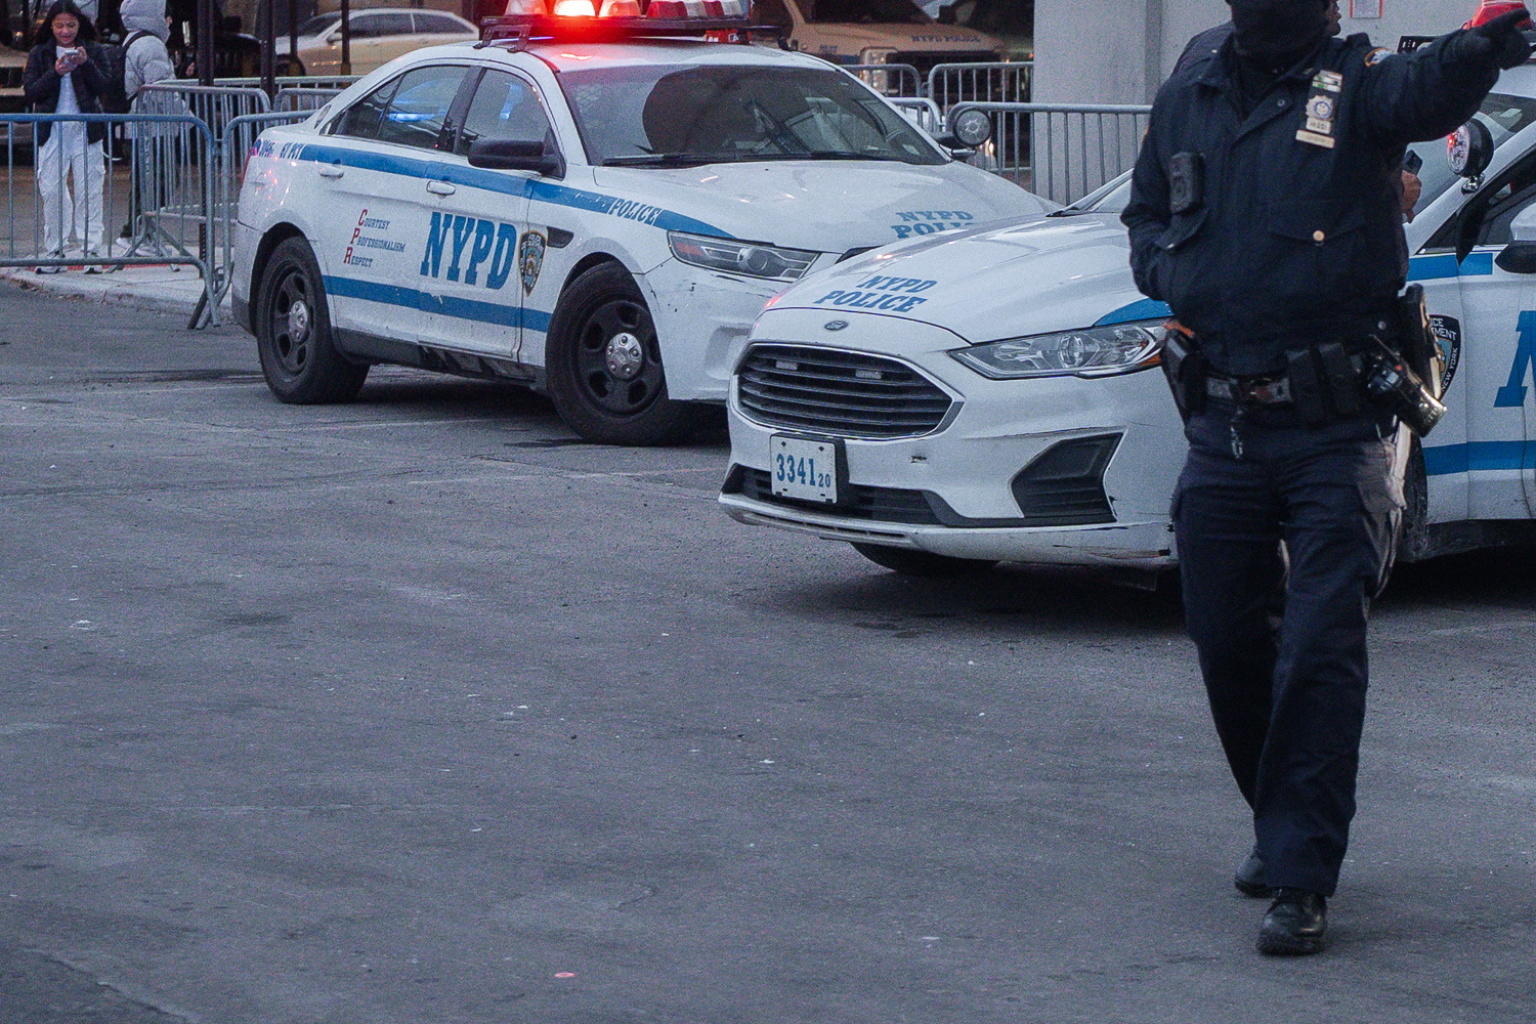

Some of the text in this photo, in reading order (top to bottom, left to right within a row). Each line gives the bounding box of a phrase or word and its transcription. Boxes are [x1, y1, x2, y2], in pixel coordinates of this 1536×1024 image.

[608, 197, 662, 226] POLICE
[896, 211, 974, 222] NYPD
[420, 211, 517, 290] NYPD
[855, 275, 938, 293] NYPD
[812, 290, 929, 313] POLICE
[776, 454, 831, 488] 3341 20
